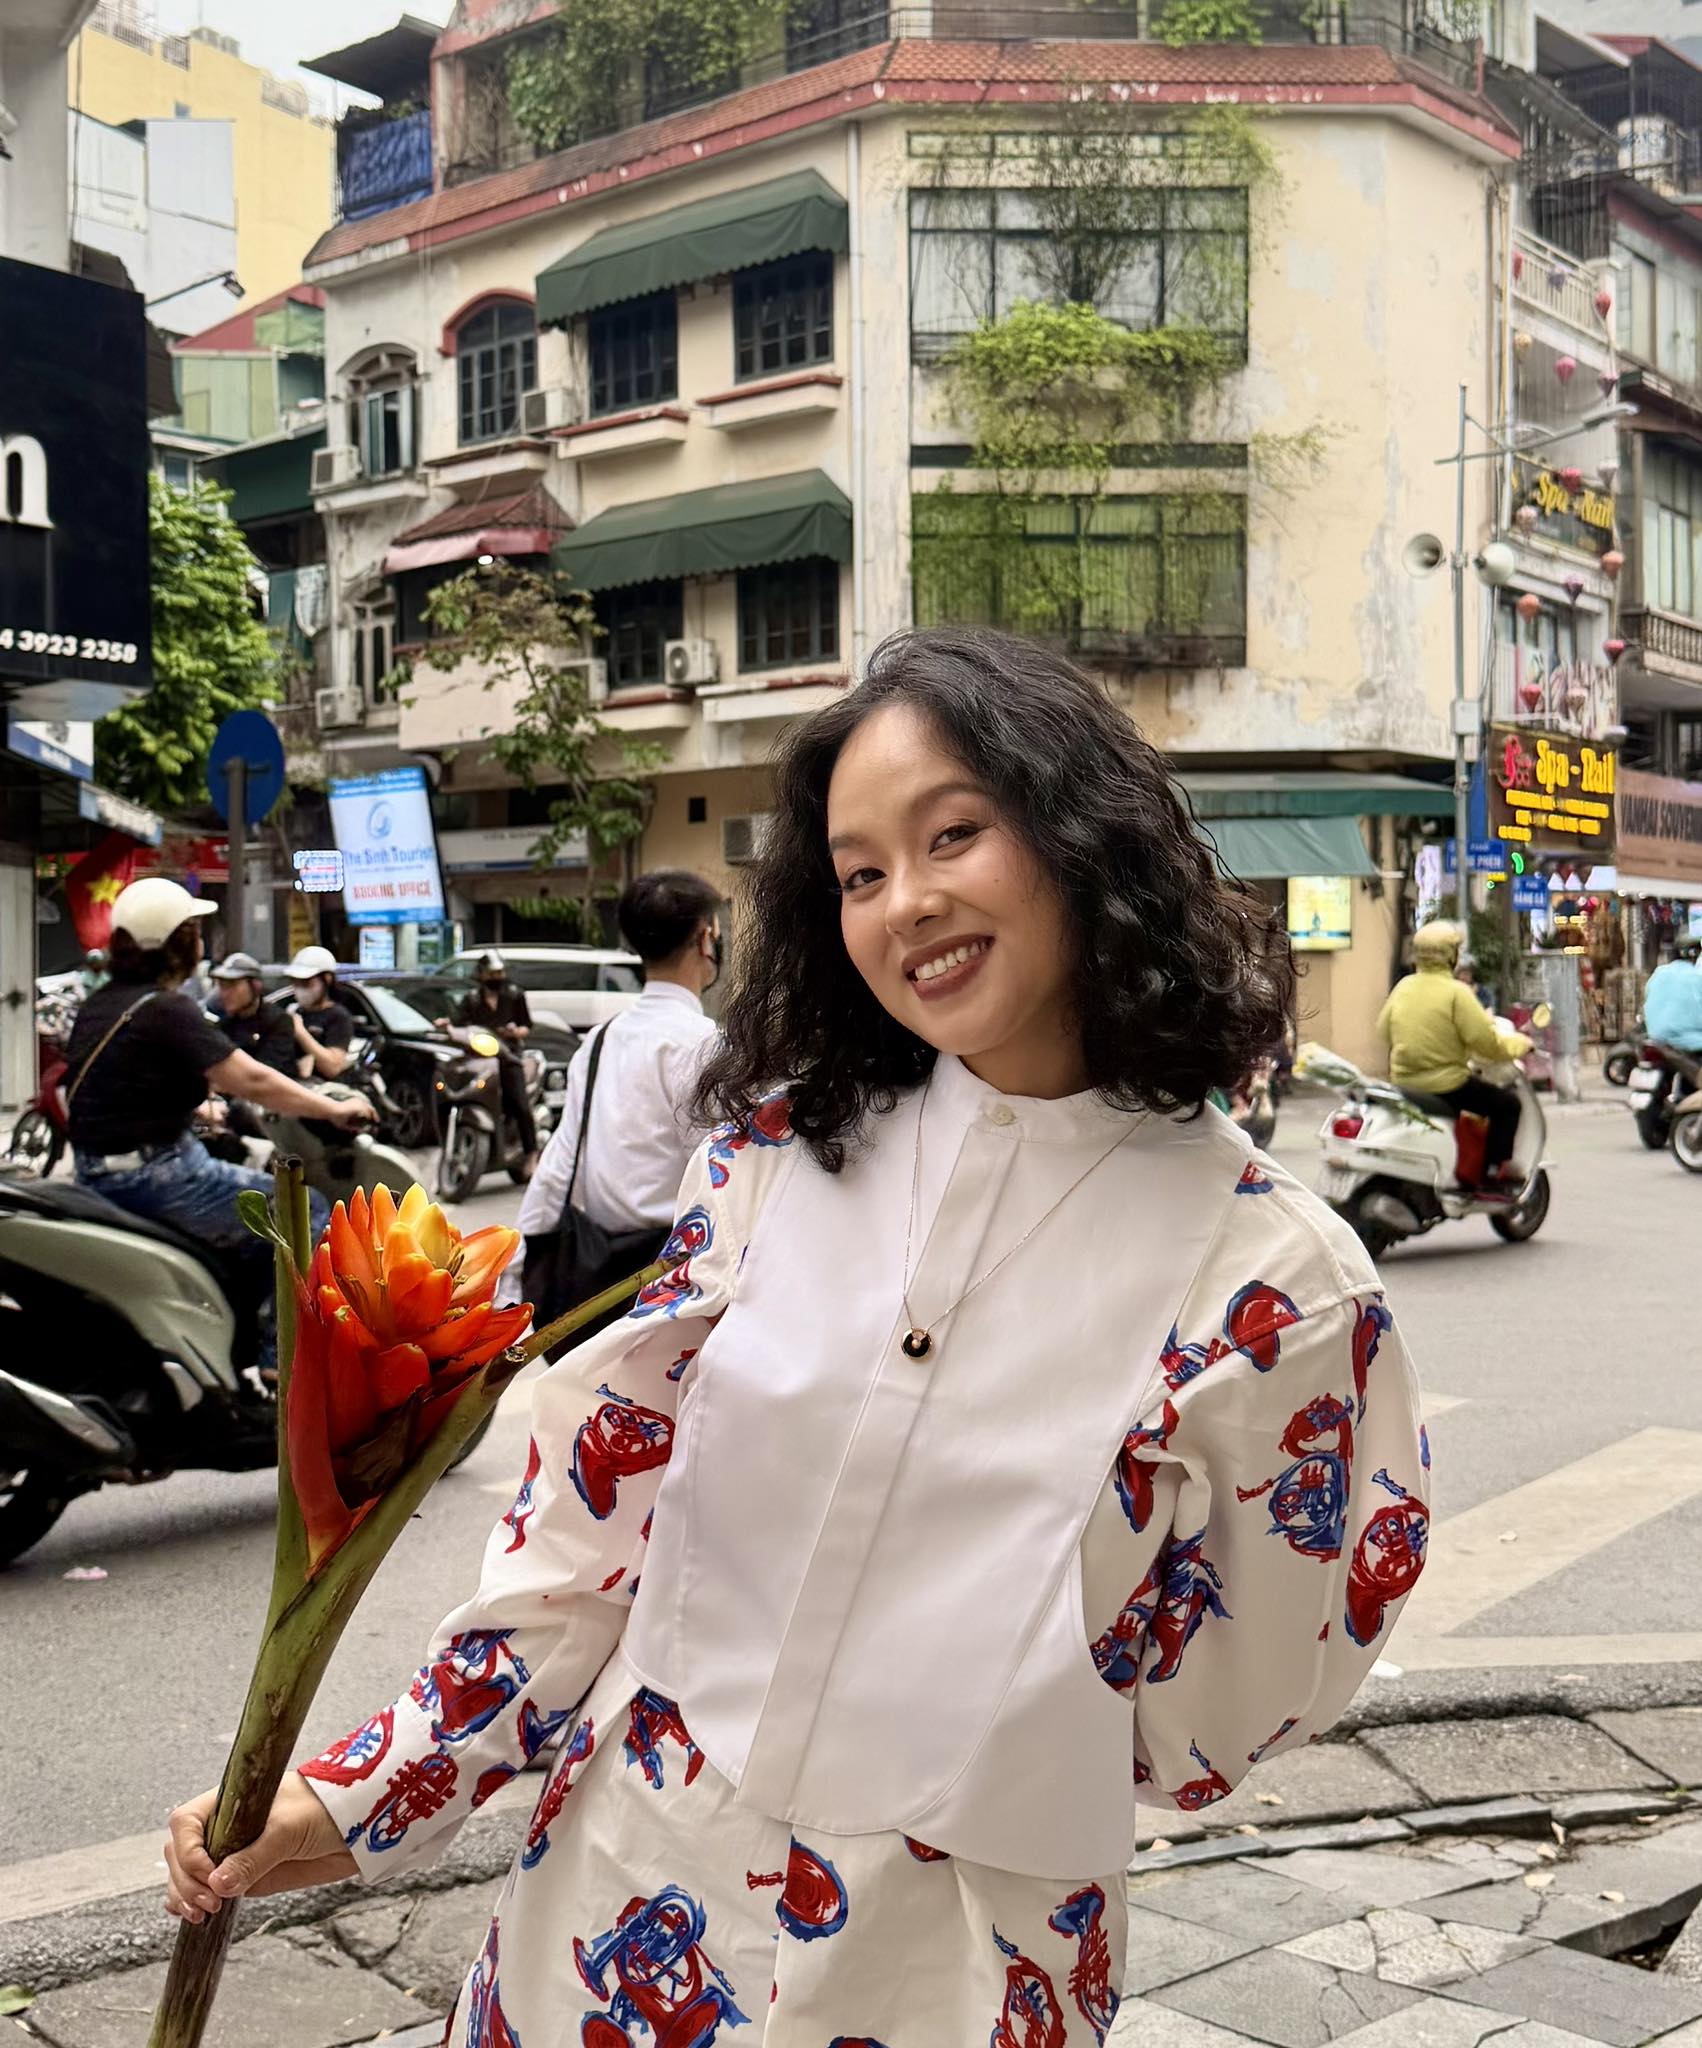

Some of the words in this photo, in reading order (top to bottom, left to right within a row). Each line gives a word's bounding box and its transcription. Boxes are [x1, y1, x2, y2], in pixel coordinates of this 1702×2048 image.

[1537, 471, 1568, 517] Spa
[18, 630, 78, 656] 3923
[80, 638, 138, 664] 2358
[1536, 739, 1570, 793] Spa
